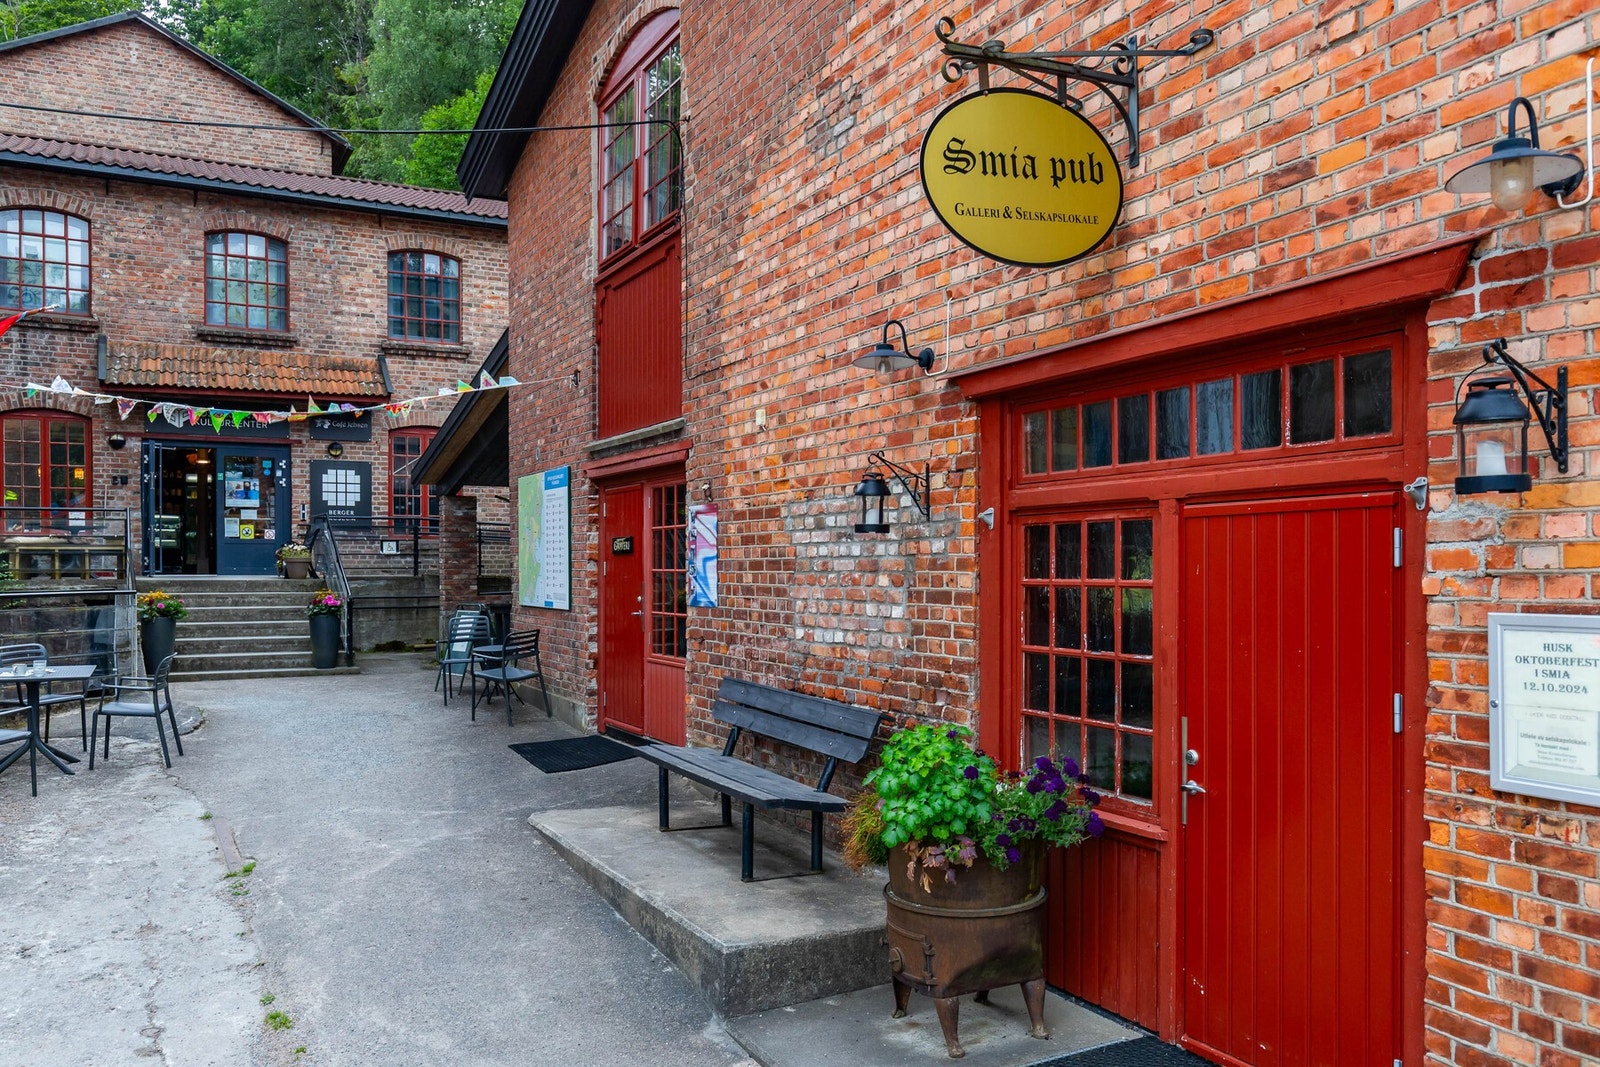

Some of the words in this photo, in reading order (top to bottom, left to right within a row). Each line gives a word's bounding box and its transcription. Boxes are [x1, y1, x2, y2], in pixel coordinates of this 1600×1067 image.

[943, 136, 1039, 181] Smia
[1049, 152, 1104, 189] pub
[954, 202, 1000, 219] GALLERI
[1002, 206, 1012, 219] &
[1015, 206, 1099, 225] SELSKAPSLOKALE
[196, 418, 268, 429] KULURSENTER
[1542, 643, 1573, 653] HUSK
[1514, 655, 1600, 668] OKTOBERFEST
[1541, 669, 1570, 679] SMIA
[1523, 682, 1588, 694] 12.10.2024
